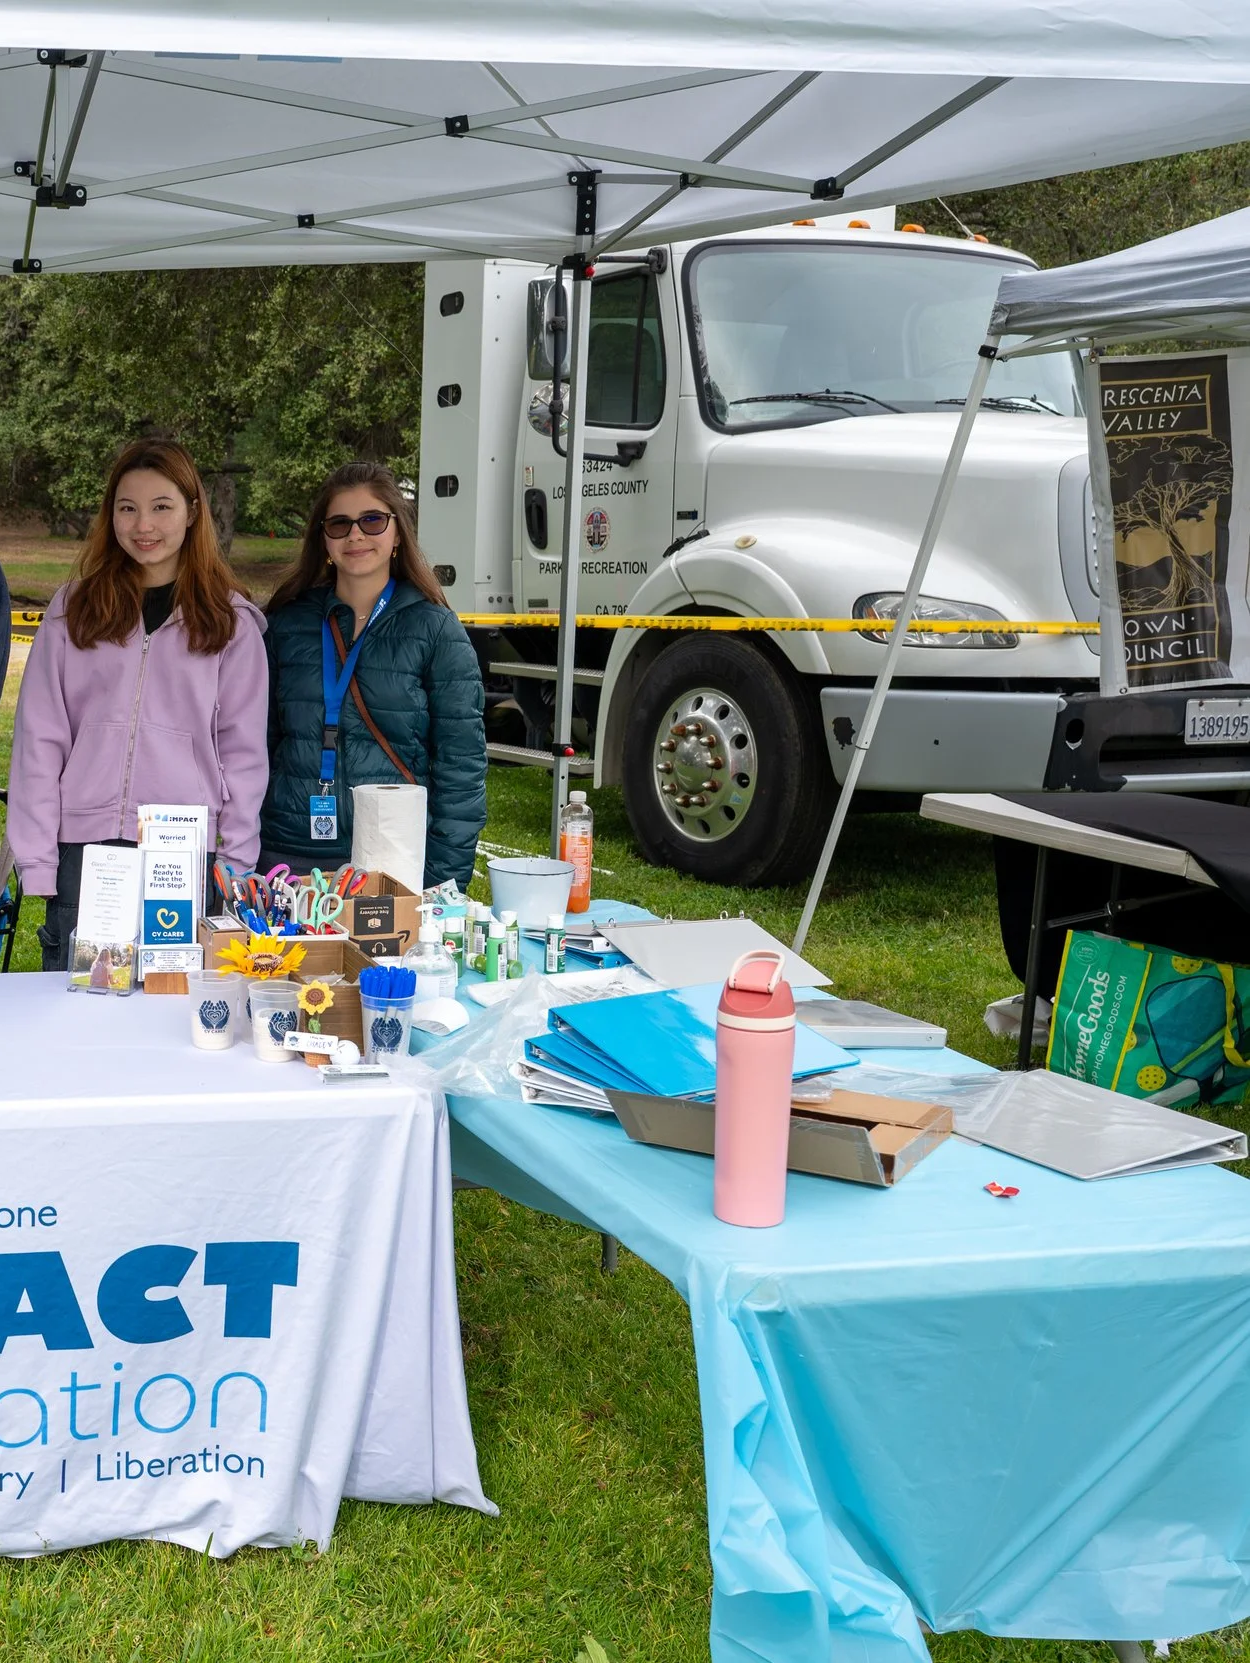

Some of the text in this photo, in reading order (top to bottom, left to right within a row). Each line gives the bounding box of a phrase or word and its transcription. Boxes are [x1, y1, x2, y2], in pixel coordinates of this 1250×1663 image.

[1103, 384, 1202, 407] RESCENTA
[1102, 411, 1181, 434] VALLEY
[582, 482, 609, 498] GELES
[611, 479, 649, 495] COUNTY
[582, 561, 648, 574] RECREATION
[1124, 613, 1186, 637] OWN
[1125, 638, 1205, 663] OUNCIL
[1189, 715, 1249, 738] 1389195
[1093, 975, 1128, 1070] HOMEGOODS.COM
[95, 1446, 265, 1481] Liberation
